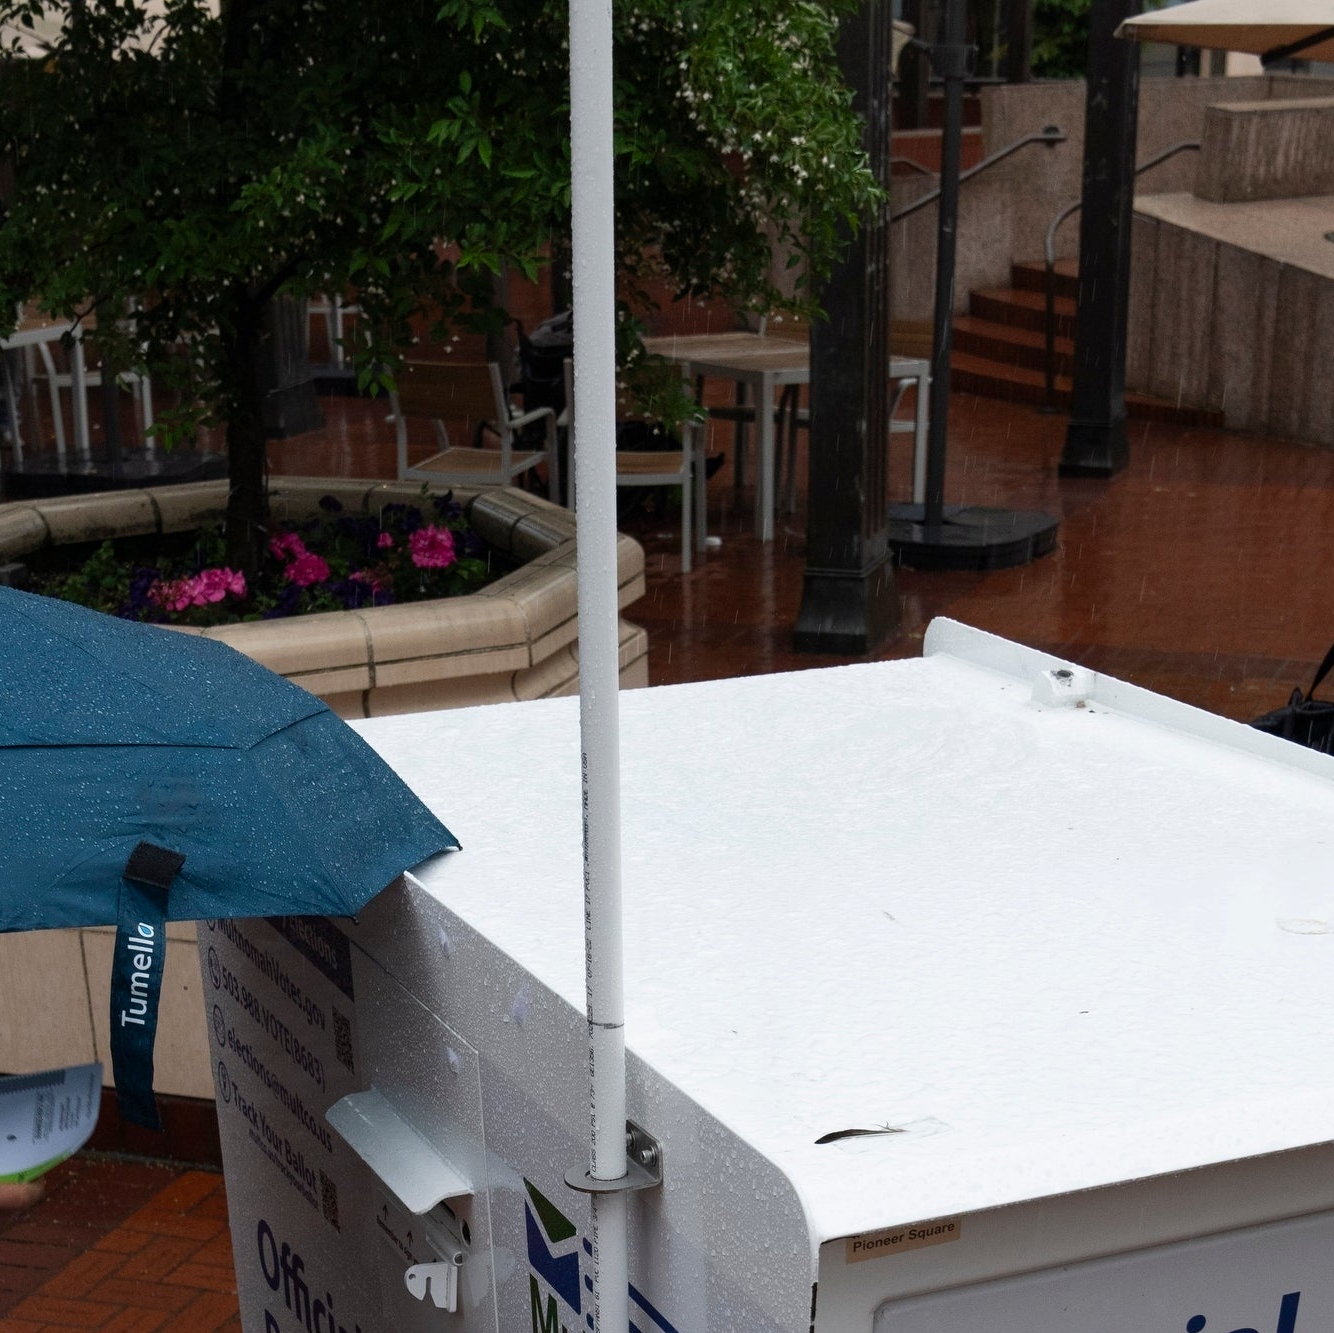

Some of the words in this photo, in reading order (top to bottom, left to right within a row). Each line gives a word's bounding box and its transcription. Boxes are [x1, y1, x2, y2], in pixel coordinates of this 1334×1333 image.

[121, 921, 155, 1028] Tumella
[222, 964, 326, 1093] 503.988.VOTE(8683)
[227, 1027, 332, 1154] elections@multco.us
[232, 1081, 258, 1129] Track
[259, 1110, 283, 1158] Your
[284, 1136, 317, 1196] Ballot
[853, 1234, 905, 1252] Pioneer
[908, 1223, 955, 1240] Square
